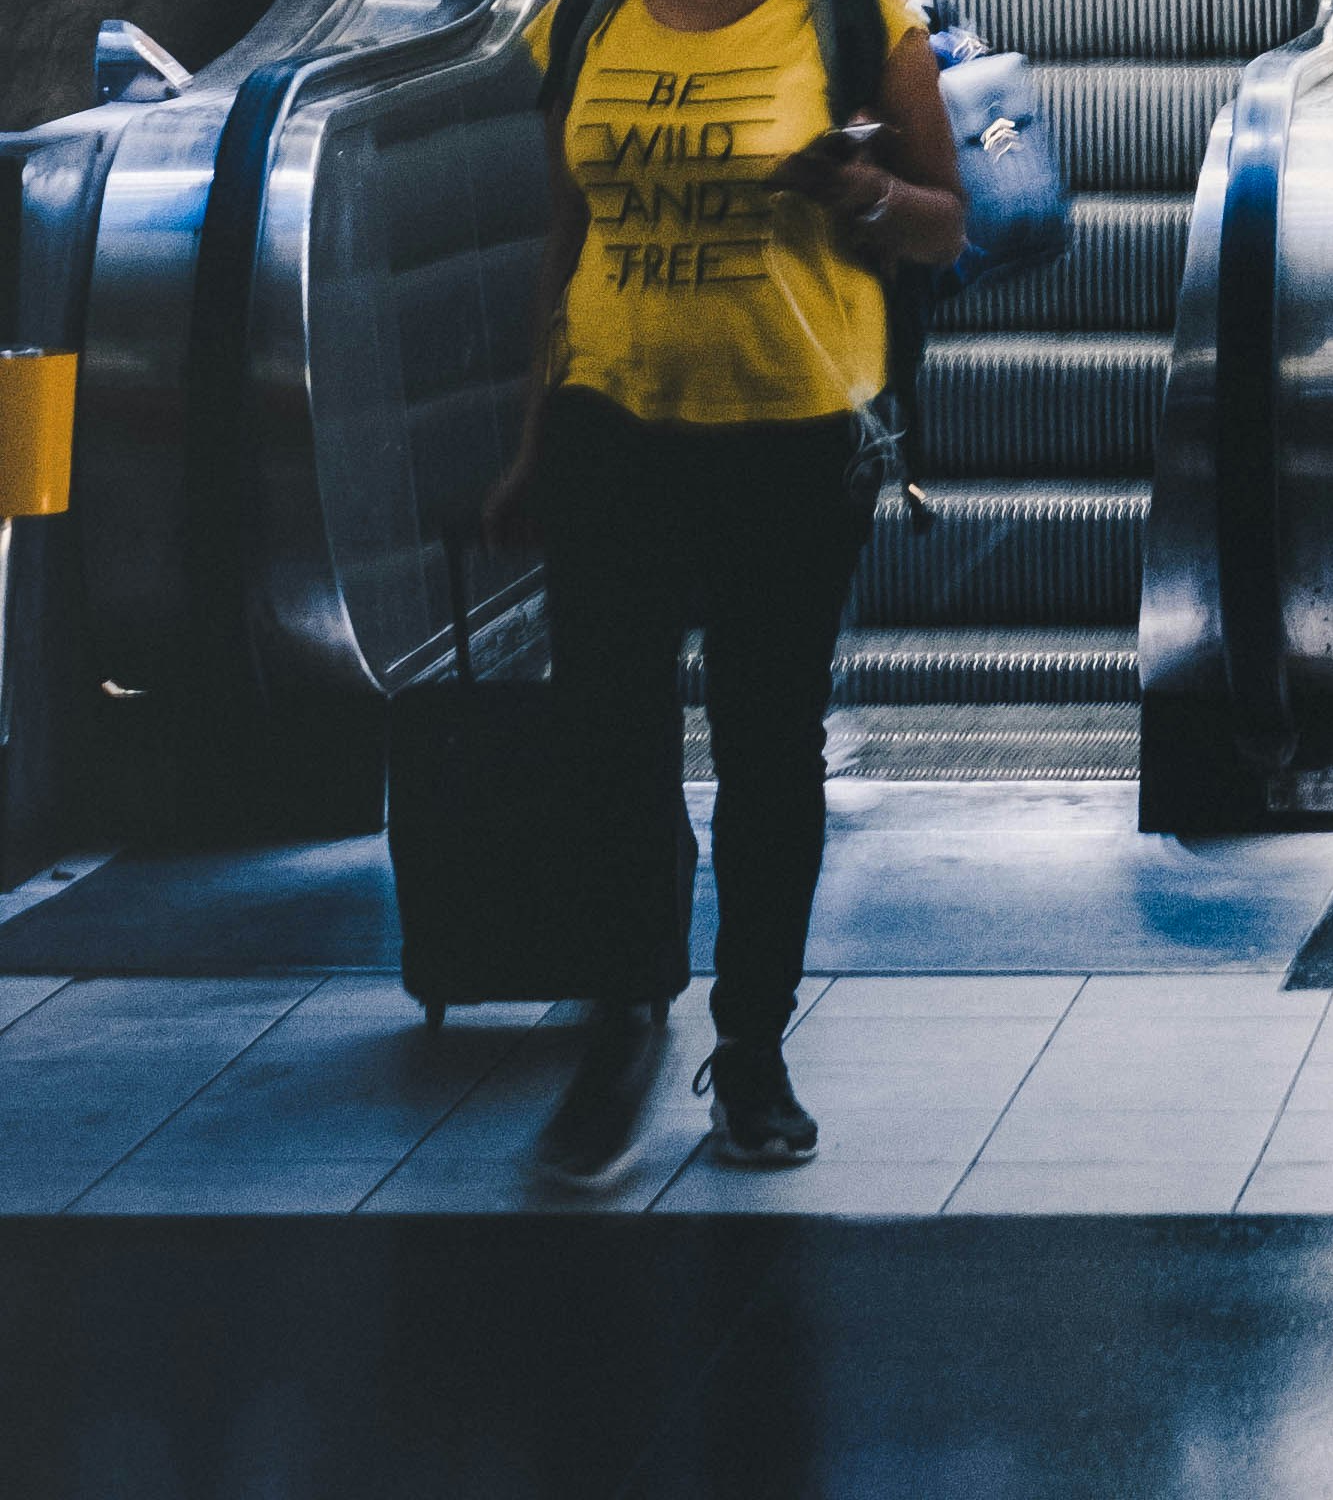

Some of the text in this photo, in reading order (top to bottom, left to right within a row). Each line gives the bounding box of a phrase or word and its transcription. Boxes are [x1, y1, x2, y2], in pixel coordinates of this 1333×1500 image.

[647, 73, 706, 108] BE
[604, 122, 734, 171] WILD
[617, 181, 732, 229] AND
